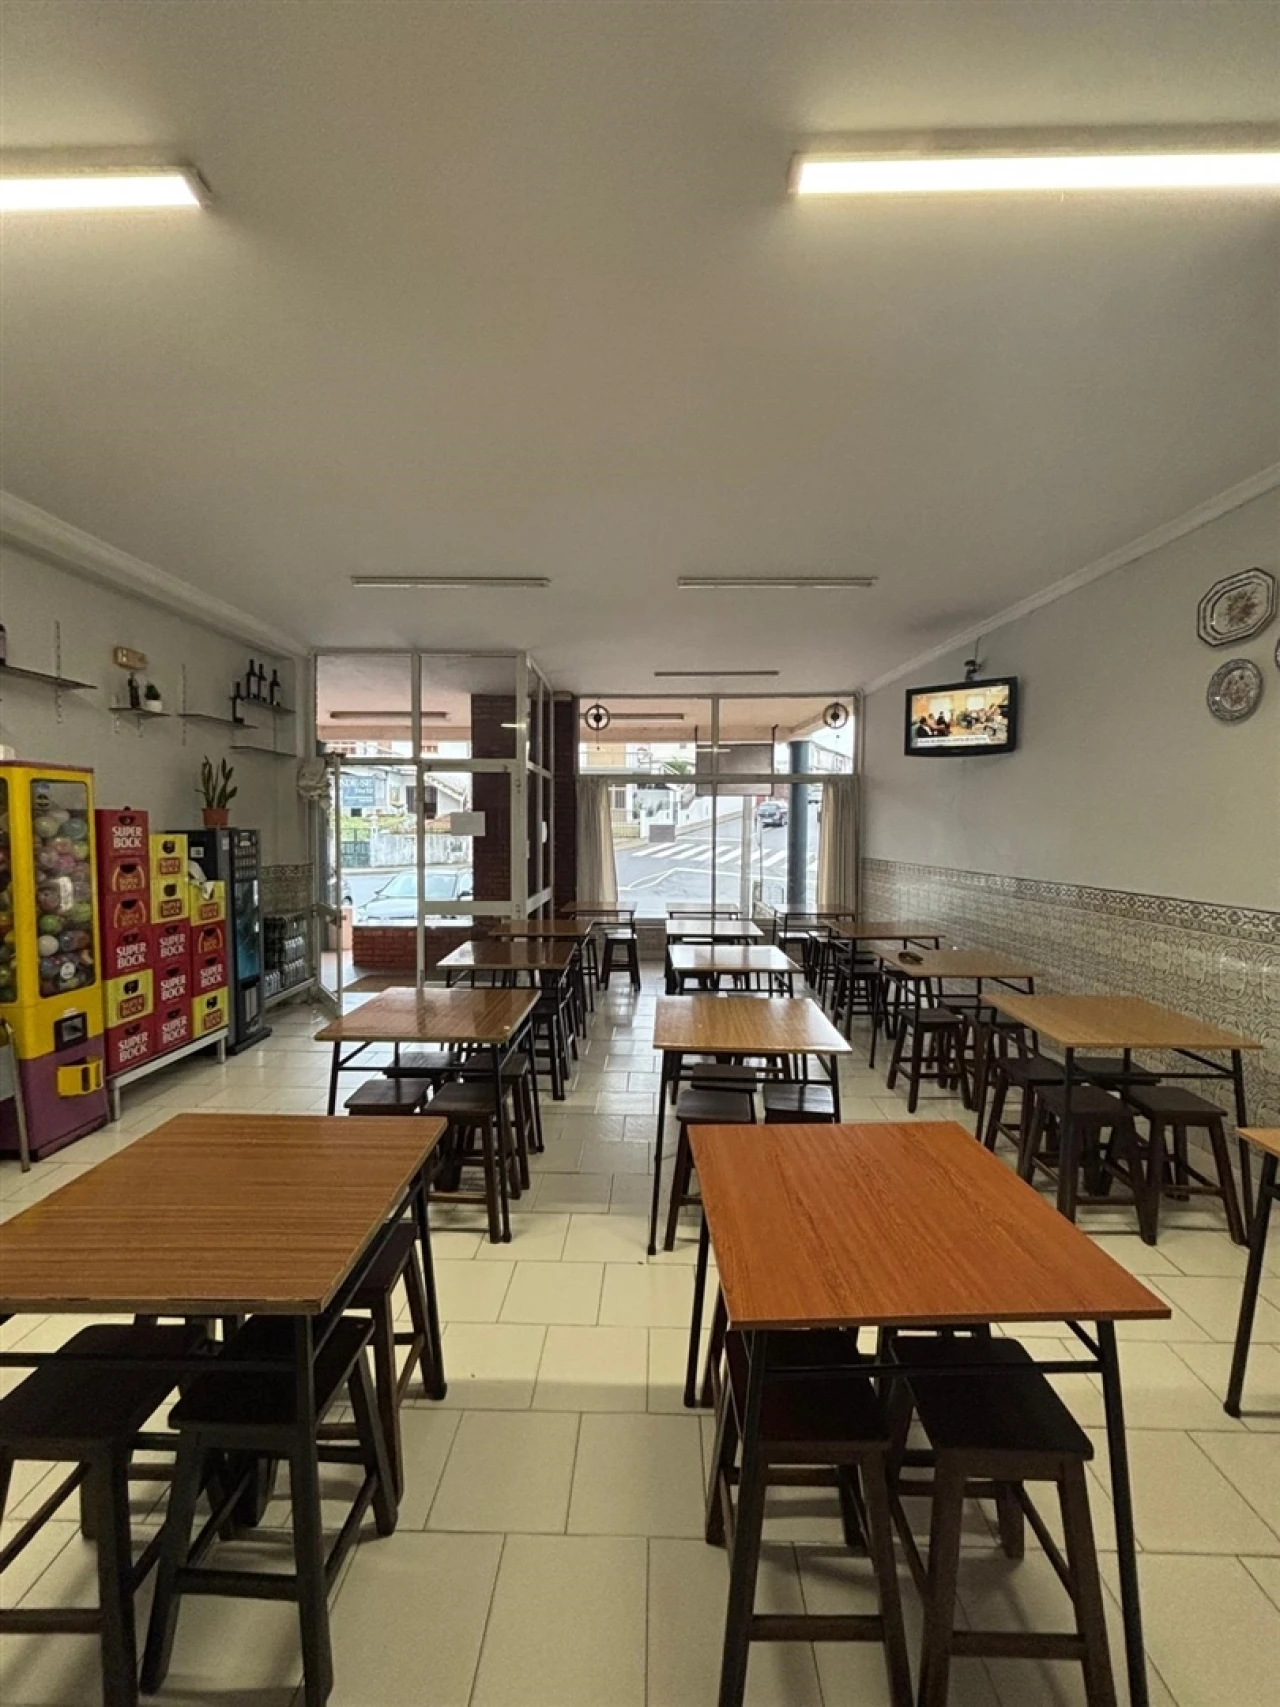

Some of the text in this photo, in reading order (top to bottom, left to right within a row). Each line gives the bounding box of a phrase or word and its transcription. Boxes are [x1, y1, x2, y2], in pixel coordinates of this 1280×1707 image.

[112, 827, 142, 838] SUPER
[114, 837, 141, 848] BOCK
[159, 934, 185, 945] SUPER
[116, 942, 147, 956] SUPER
[161, 944, 184, 958] BOCK
[117, 954, 145, 969] BOCK
[200, 964, 223, 977] SUPER
[160, 975, 186, 988] SUPER
[201, 975, 222, 988] BOCK
[161, 986, 185, 1001] BOCK
[162, 1016, 187, 1032] SUPER
[118, 1032, 148, 1048] SUPER
[163, 1028, 187, 1043] BOCK
[119, 1044, 147, 1062] BOCK
